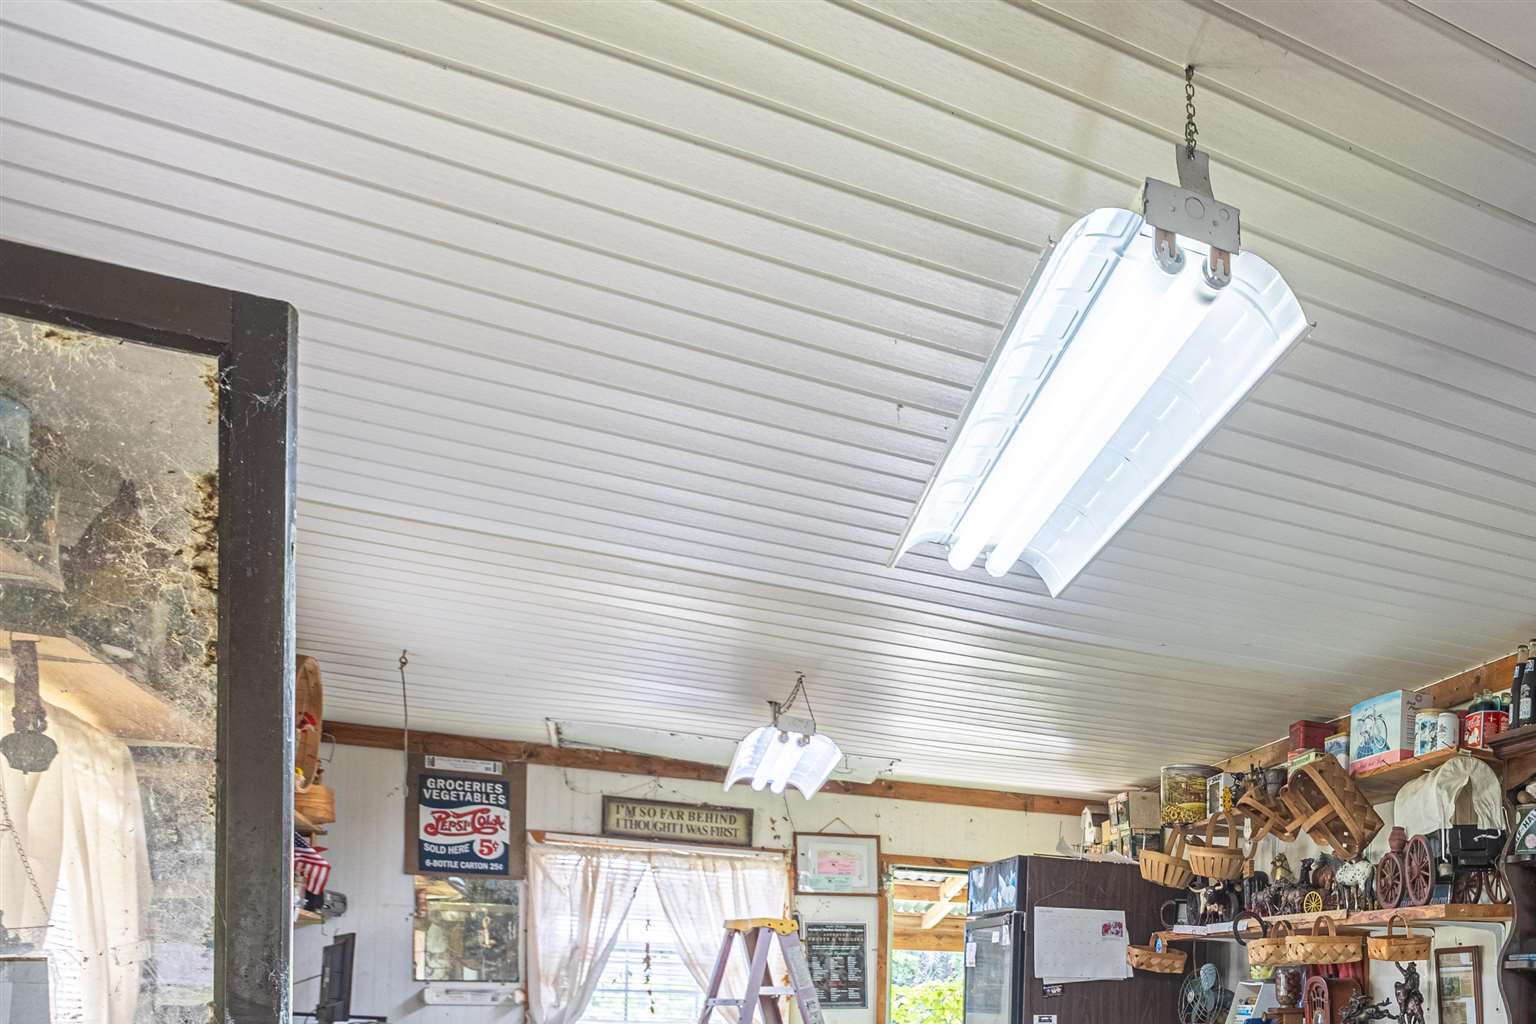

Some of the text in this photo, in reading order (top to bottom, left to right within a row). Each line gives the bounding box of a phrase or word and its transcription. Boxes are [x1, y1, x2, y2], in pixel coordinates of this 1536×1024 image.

[426, 777, 504, 794] GROCERIES
[422, 788, 507, 805] VEGETABLES
[615, 804, 737, 826] I'M SO FAR BEHIND
[615, 818, 621, 829] I
[622, 818, 678, 833] THOUGHT
[683, 823, 710, 836] WAS
[710, 826, 742, 839] FIRST
[423, 843, 447, 855] SOLD
[447, 843, 471, 855] HERE
[424, 858, 459, 869] 6-BOTTLE
[459, 860, 489, 870] CARTON
